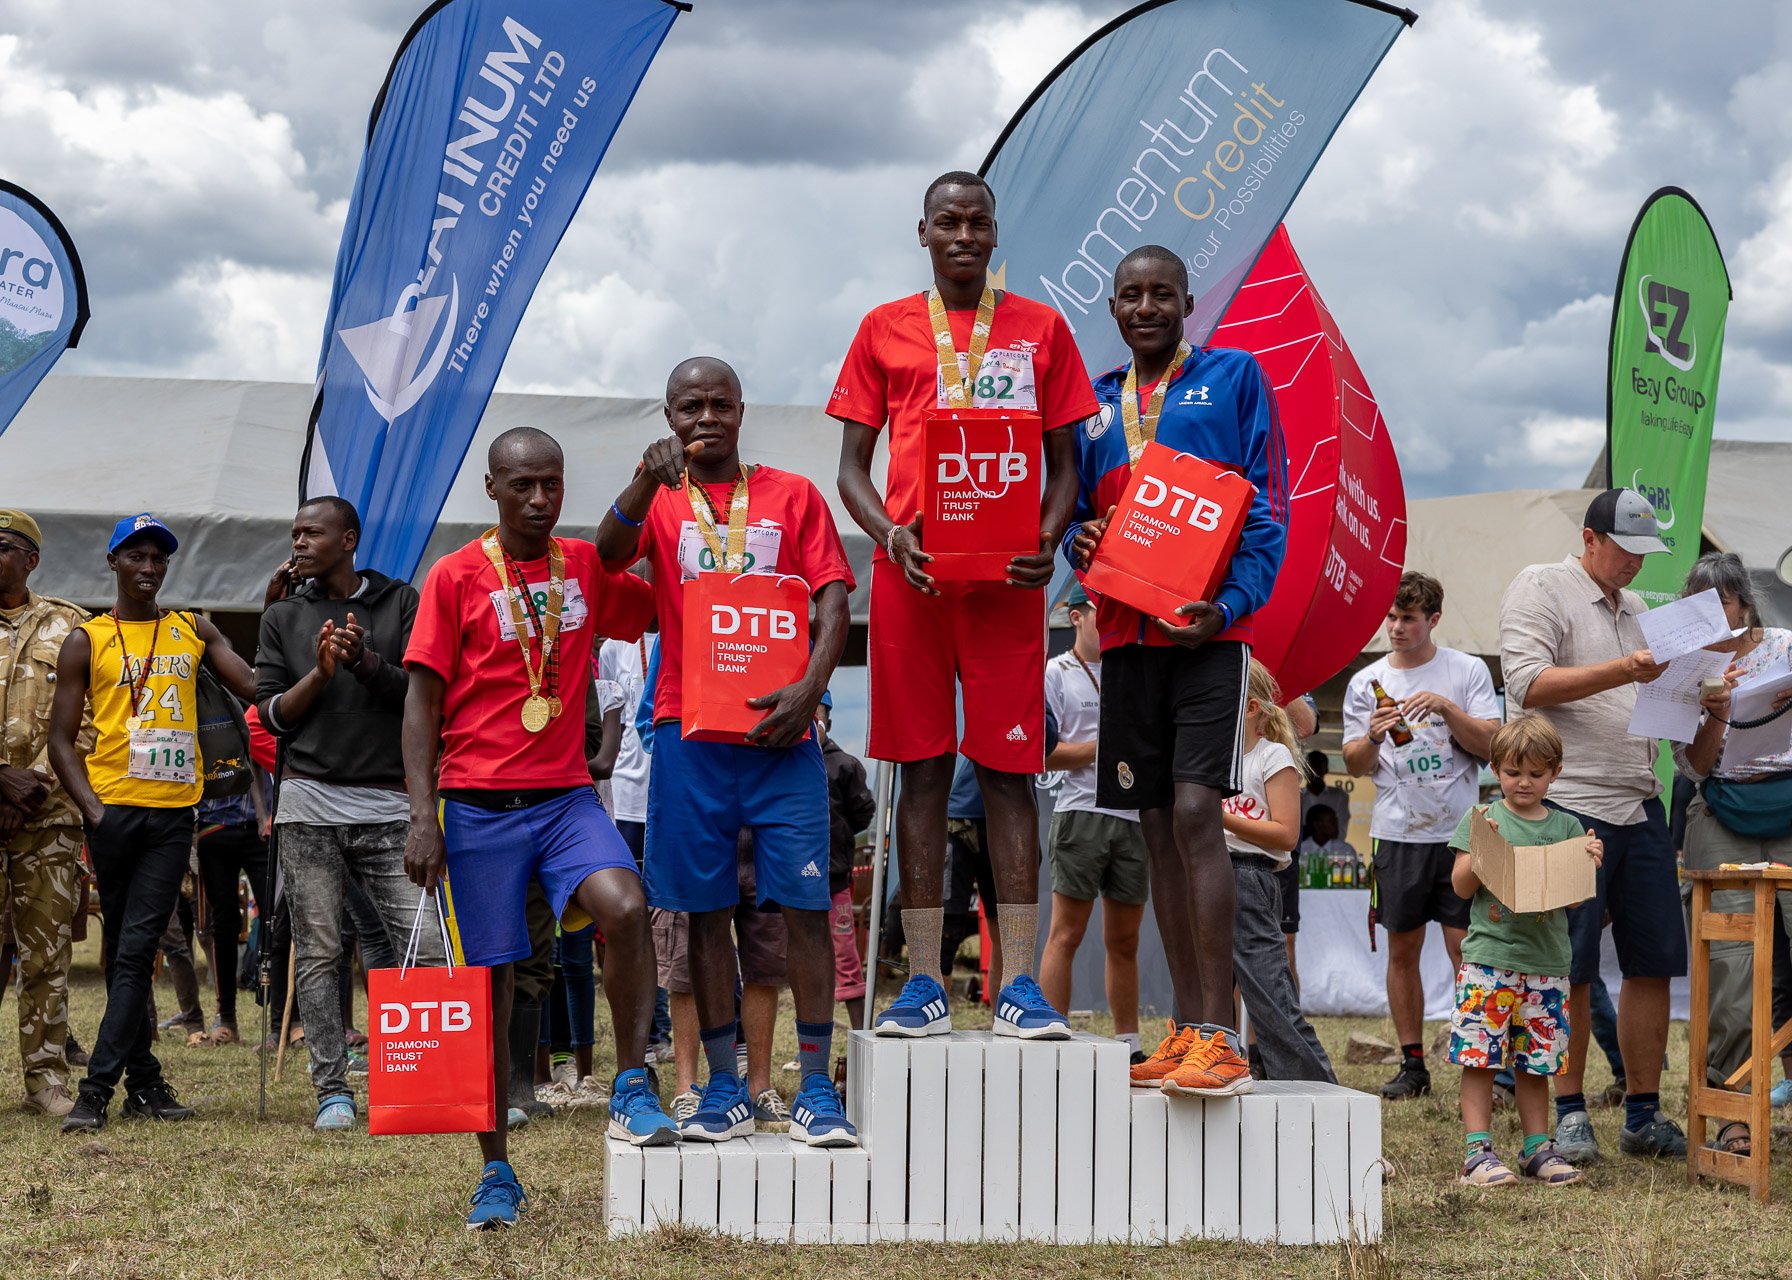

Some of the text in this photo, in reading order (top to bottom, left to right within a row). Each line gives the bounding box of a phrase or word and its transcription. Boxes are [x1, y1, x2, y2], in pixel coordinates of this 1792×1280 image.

[479, 50, 566, 217] CREDIT LTD
[1174, 82, 1285, 220] Credit
[1186, 110, 1305, 278] Your Possibilities
[447, 76, 597, 373] There when you need us
[1645, 281, 1690, 362] EZ
[1665, 376, 1706, 415] Group
[938, 452, 1028, 483] DTB
[943, 490, 996, 499] DIAMOND
[943, 502, 980, 510] TRUST
[1133, 474, 1223, 532] DTB
[1347, 473, 1365, 511] with
[1367, 494, 1381, 523] us.
[943, 513, 974, 521] BANK
[1129, 520, 1162, 540] TRUST
[1132, 510, 1181, 536] DIAMOND
[1123, 530, 1153, 548] BANK
[1349, 511, 1358, 539] on
[1360, 522, 1371, 552] us.
[698, 547, 756, 573] 02
[711, 604, 797, 640] DTB
[717, 641, 768, 653] DIAMOND
[717, 653, 753, 663] TRUST
[717, 664, 747, 673] BANK
[134, 683, 184, 722] 24
[148, 747, 186, 768] 118
[1407, 753, 1442, 774] 105
[380, 1001, 472, 1034] DTB
[386, 1040, 439, 1050] DIAMOND
[386, 1051, 423, 1061] TRUST
[386, 1063, 418, 1073] BANK
